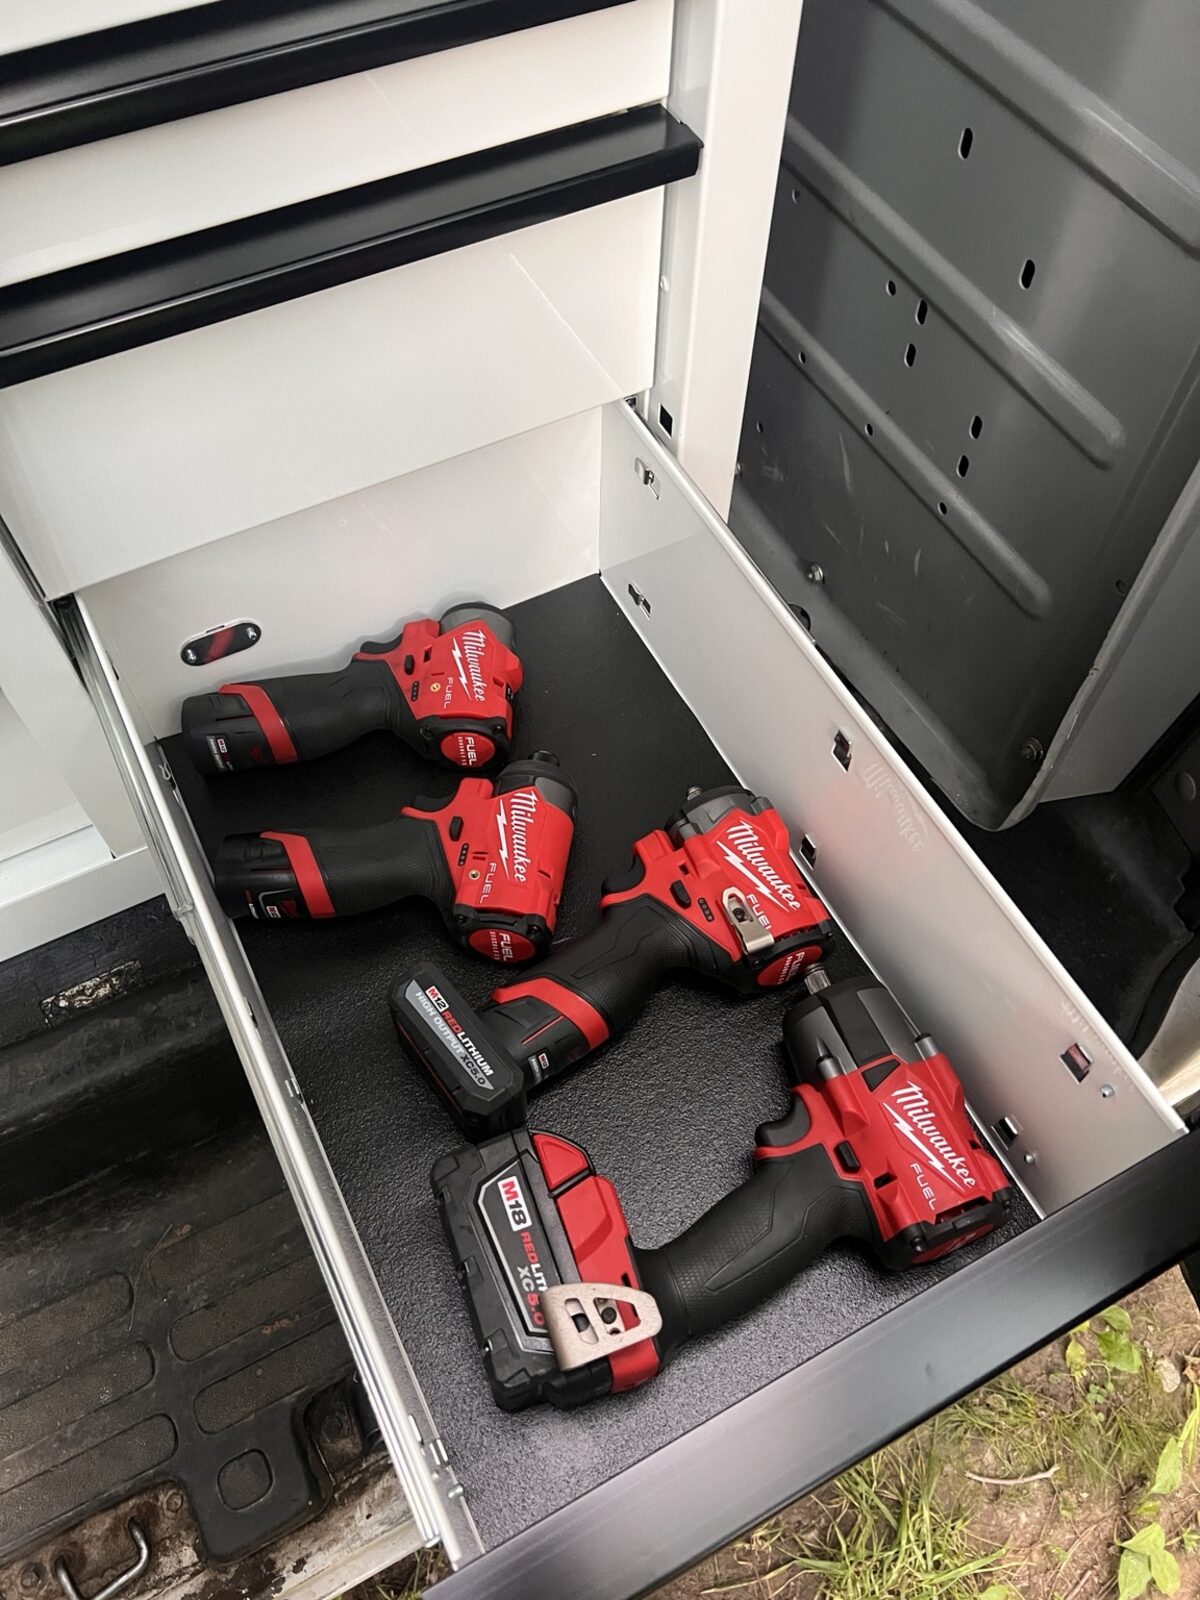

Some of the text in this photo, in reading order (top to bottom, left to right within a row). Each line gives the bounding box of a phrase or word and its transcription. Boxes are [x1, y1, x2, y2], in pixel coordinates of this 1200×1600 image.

[444, 677, 454, 710] FUEL
[462, 630, 487, 702] Milwaukee
[465, 736, 477, 766] FUEL
[510, 790, 539, 883] Milwaukee
[726, 820, 801, 912] Milwaukee
[480, 862, 497, 904] FUEL
[499, 932, 513, 962] FUEL
[415, 991, 486, 1085] HIGH OUTPUT XC5.0
[427, 987, 494, 1076] M12 REDLITHIUM
[891, 1080, 976, 1191] Milwaukee
[501, 1179, 528, 1228] M18
[910, 1163, 936, 1210] FUEL
[517, 1265, 545, 1326] XC5.0
